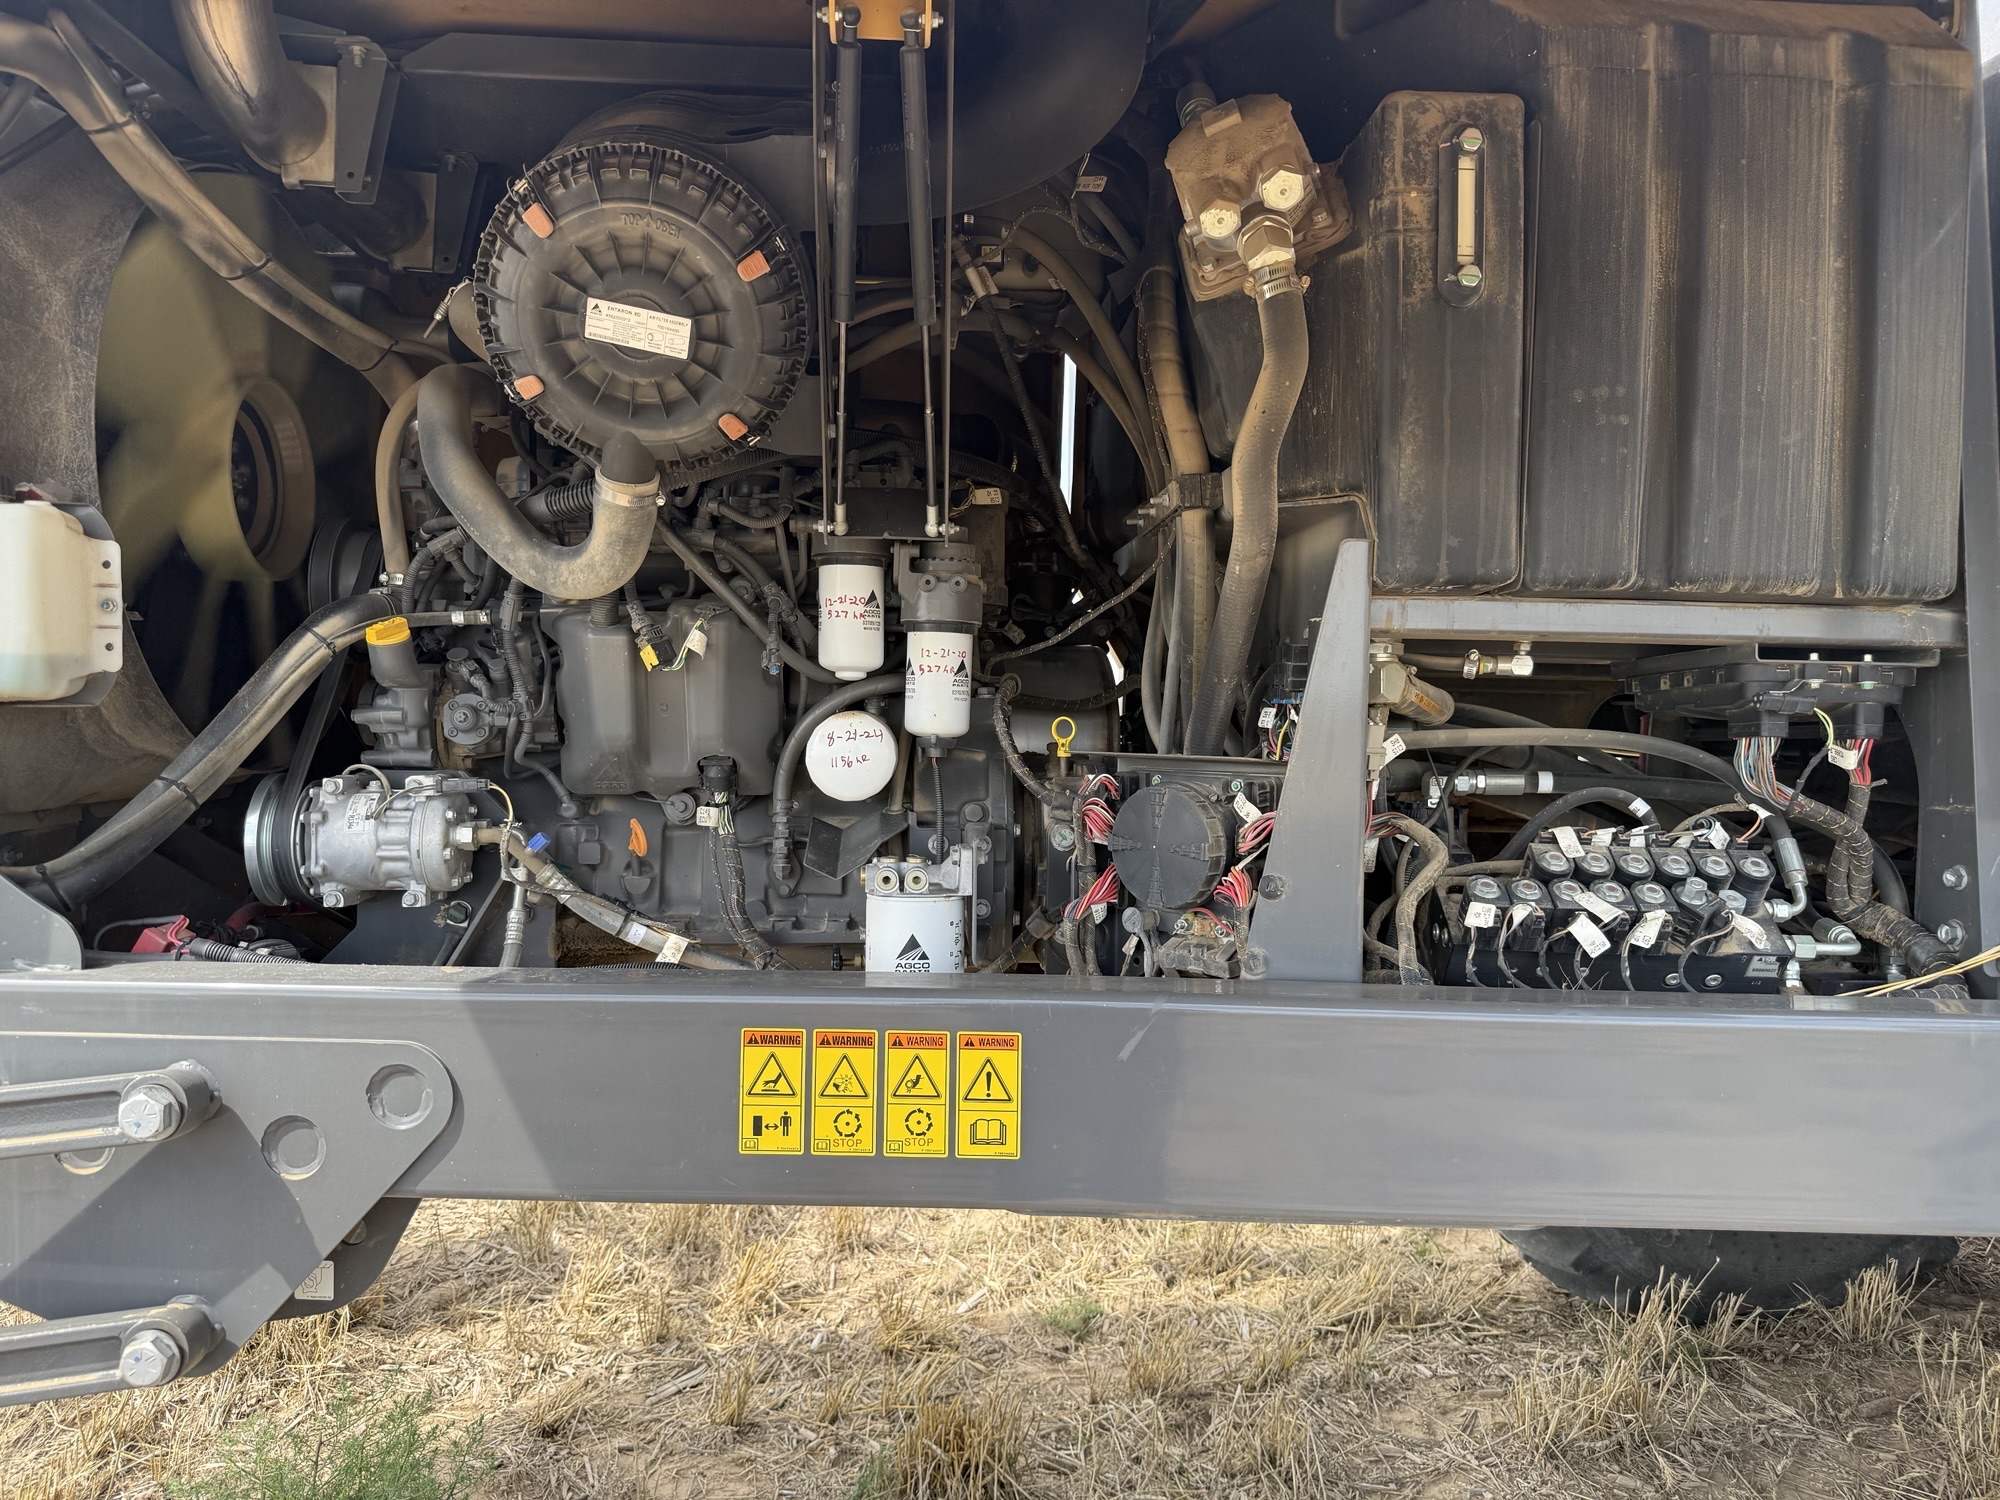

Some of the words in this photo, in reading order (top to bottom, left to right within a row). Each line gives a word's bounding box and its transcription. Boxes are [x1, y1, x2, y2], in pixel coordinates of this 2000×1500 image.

[620, 212, 641, 226] TOP
[607, 306, 632, 316] ENTARON
[825, 594, 866, 608] 12-21-20
[827, 610, 848, 620] 527
[920, 648, 966, 658] 12-21-20
[918, 664, 940, 676] 527
[760, 1034, 800, 1046] WARNING
[832, 1036, 873, 1046] WARNING
[906, 1036, 944, 1047] WARNING
[978, 1037, 1015, 1048] WARNING
[833, 1138, 863, 1148] STOP
[904, 1138, 934, 1147] STOP
